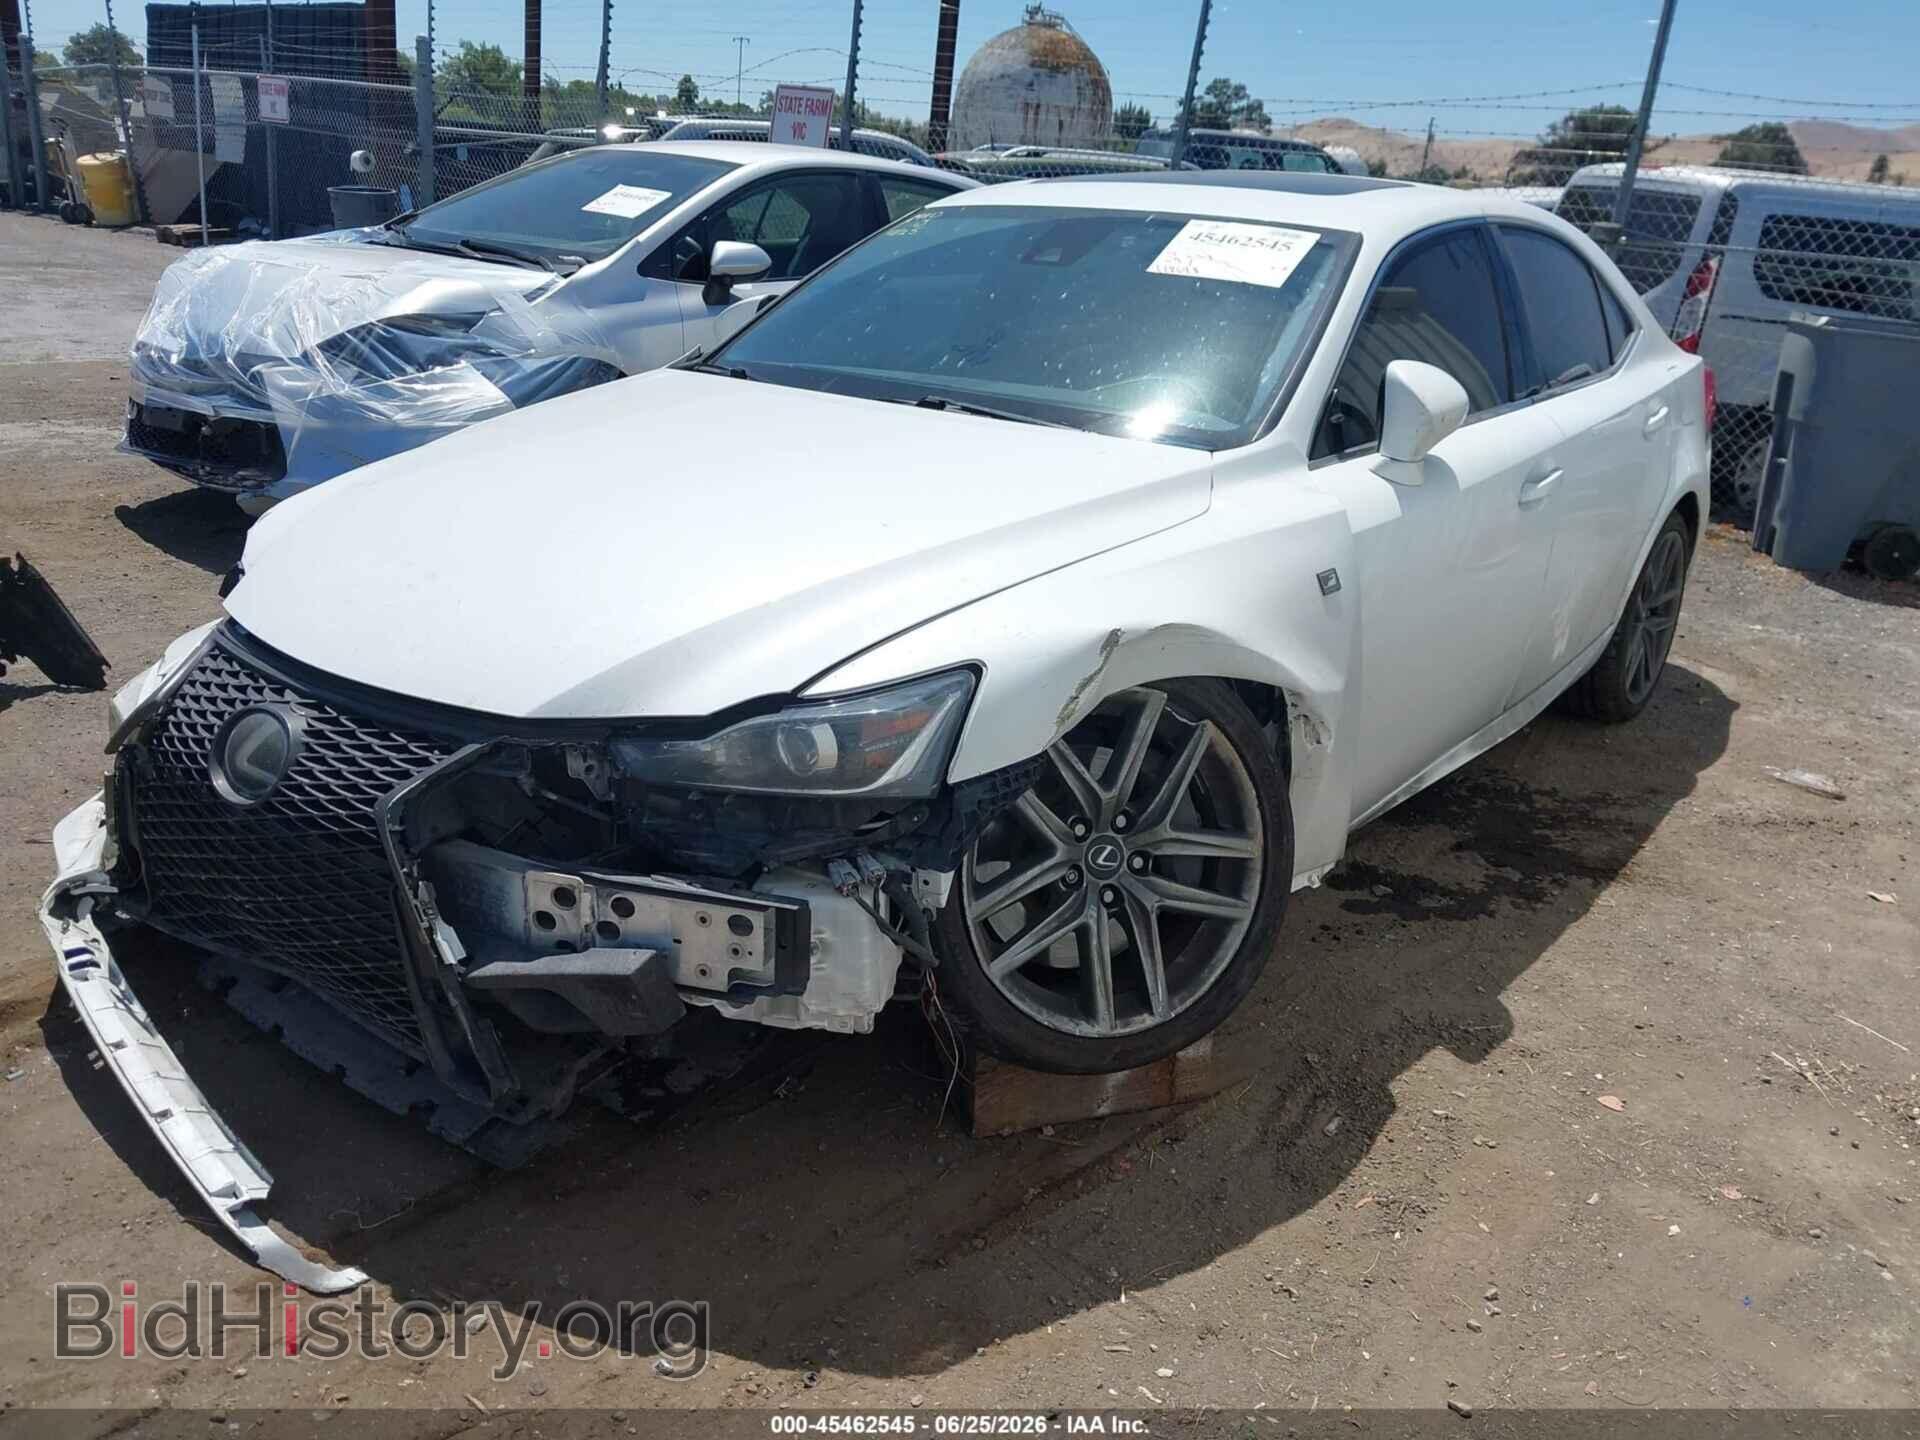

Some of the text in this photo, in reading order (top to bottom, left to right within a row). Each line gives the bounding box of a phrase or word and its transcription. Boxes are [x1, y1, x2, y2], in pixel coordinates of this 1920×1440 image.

[777, 95, 833, 116] STATE FARM
[1189, 232, 1296, 252] 45462545
